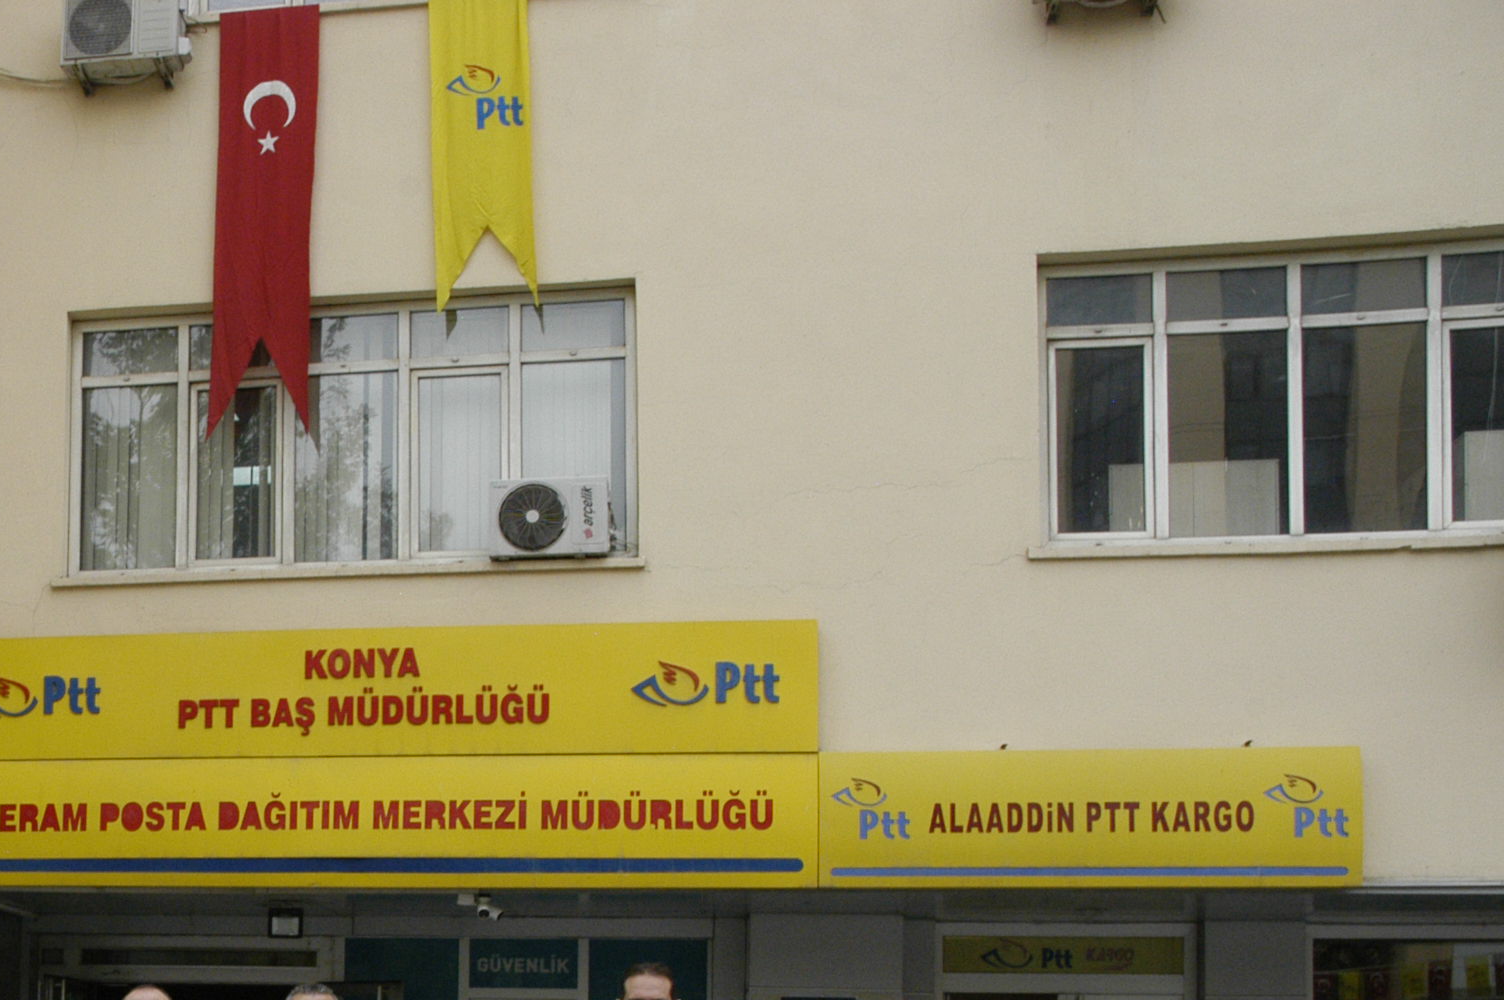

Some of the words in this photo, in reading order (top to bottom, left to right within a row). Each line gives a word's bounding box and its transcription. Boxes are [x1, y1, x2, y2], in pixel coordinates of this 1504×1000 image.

[477, 95, 523, 129] Ptt
[304, 647, 421, 680] KONYA
[43, 676, 100, 715] Ptt
[716, 661, 780, 703] Ptt
[177, 698, 240, 729] PTT
[250, 697, 315, 736] BAŞ
[327, 685, 551, 728] MÜDÜRLÜĞÜ
[99, 801, 207, 833] POSTA
[217, 792, 361, 832] DAĞITIM
[372, 790, 527, 831] MERKEZİ
[540, 788, 774, 831] MÜDÜRLÜĞÜ
[859, 809, 910, 840] Ptt
[1086, 801, 1140, 833] PTT
[1151, 800, 1255, 833] KARGO
[1295, 806, 1349, 838] Ptt
[476, 953, 570, 975] GÜVENLİK
[1041, 947, 1073, 969] Ptt
